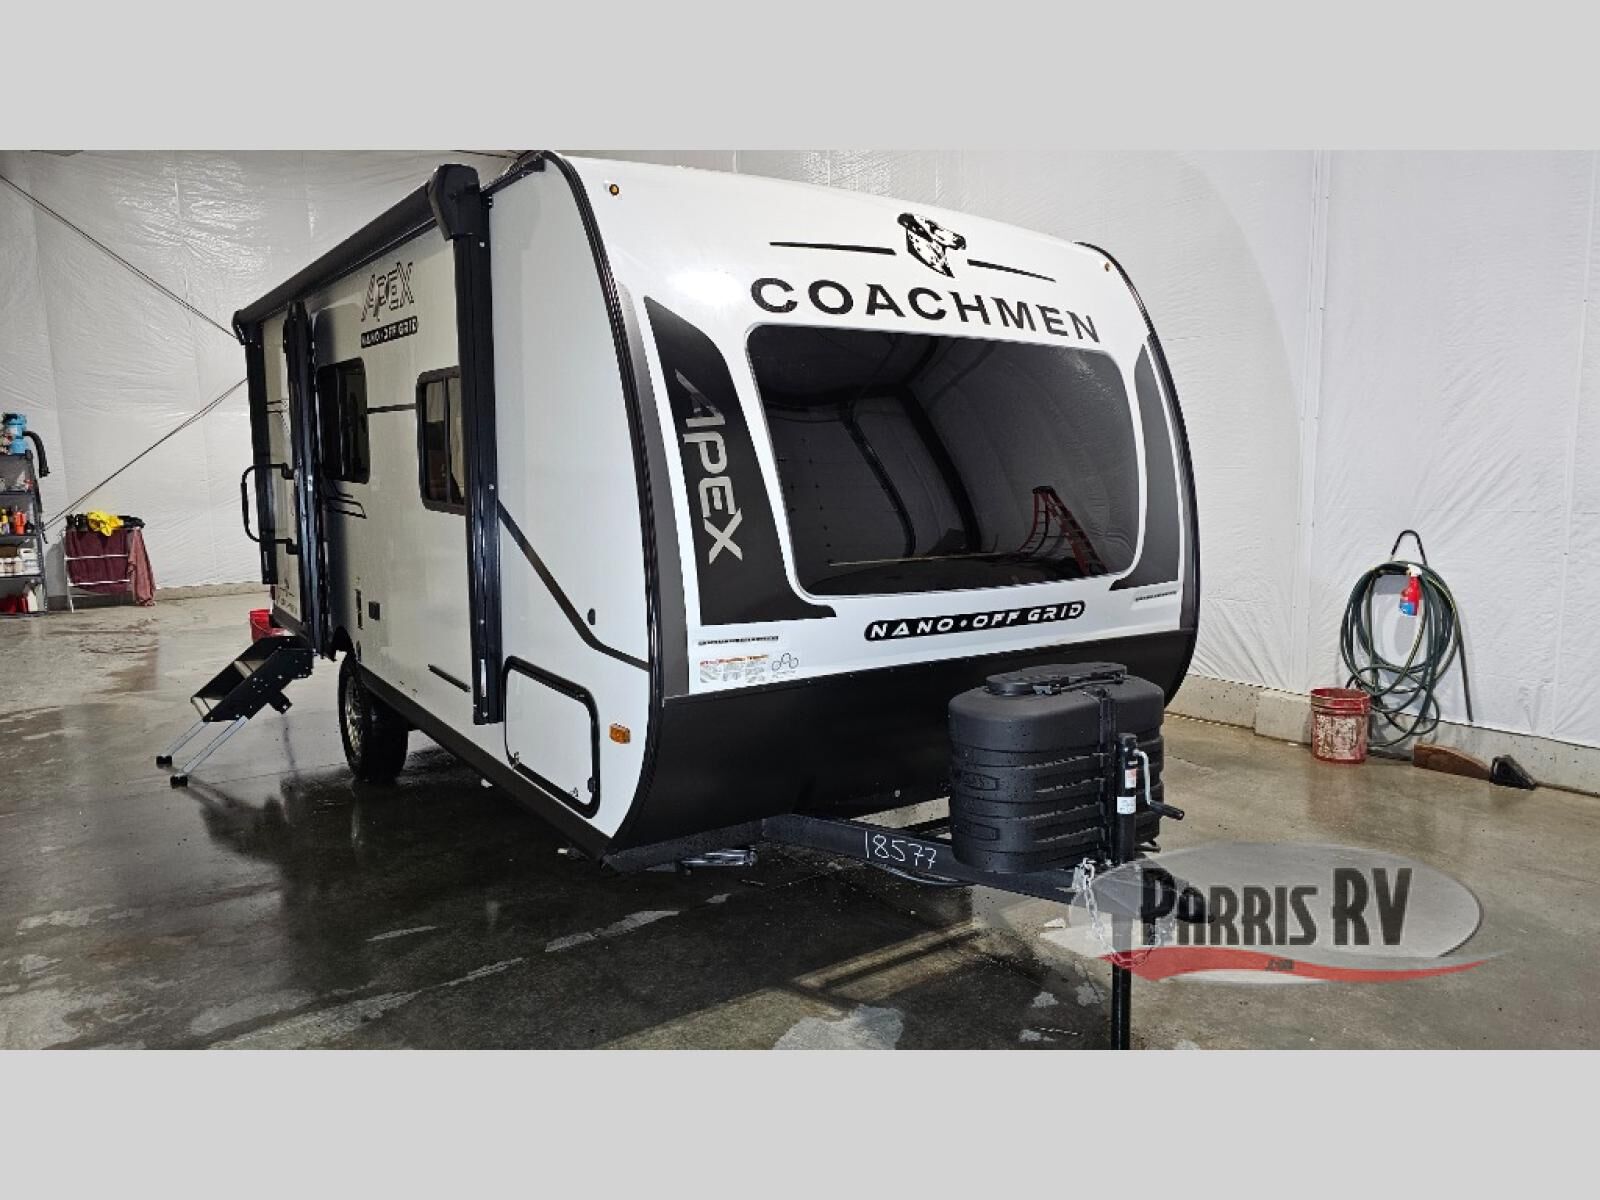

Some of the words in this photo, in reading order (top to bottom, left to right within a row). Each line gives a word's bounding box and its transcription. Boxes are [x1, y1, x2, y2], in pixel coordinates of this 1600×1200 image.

[361, 262, 414, 322] APEX
[750, 277, 1100, 344] COACHMEN
[675, 368, 743, 565] APEX
[1027, 603, 1083, 622] GRID
[865, 831, 937, 869] 18577
